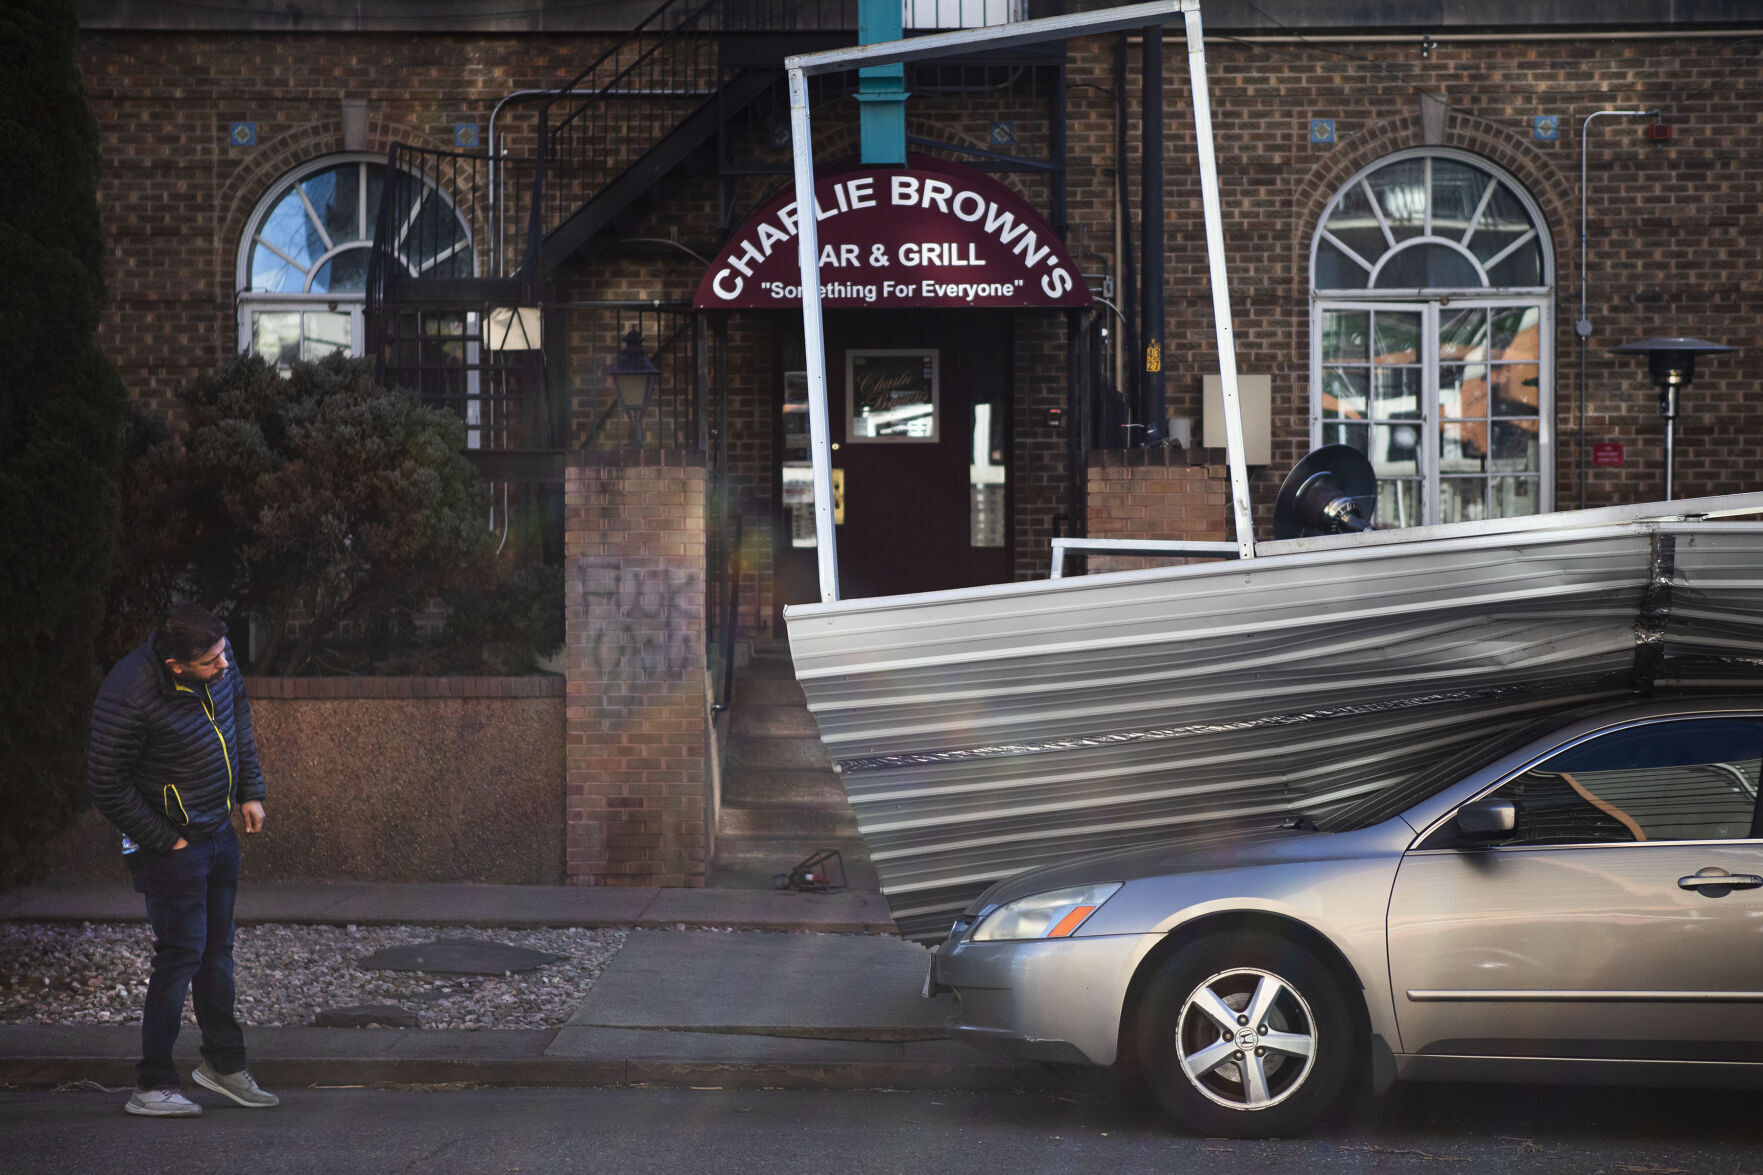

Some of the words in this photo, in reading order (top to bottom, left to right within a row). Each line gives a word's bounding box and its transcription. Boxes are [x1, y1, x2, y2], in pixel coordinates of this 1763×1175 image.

[891, 176, 1073, 299] BROWN'S
[799, 244, 860, 267] AR
[869, 244, 889, 267] &
[898, 243, 985, 266] GRILL
[883, 282, 917, 298] For
[921, 280, 1024, 301] Everyone"
